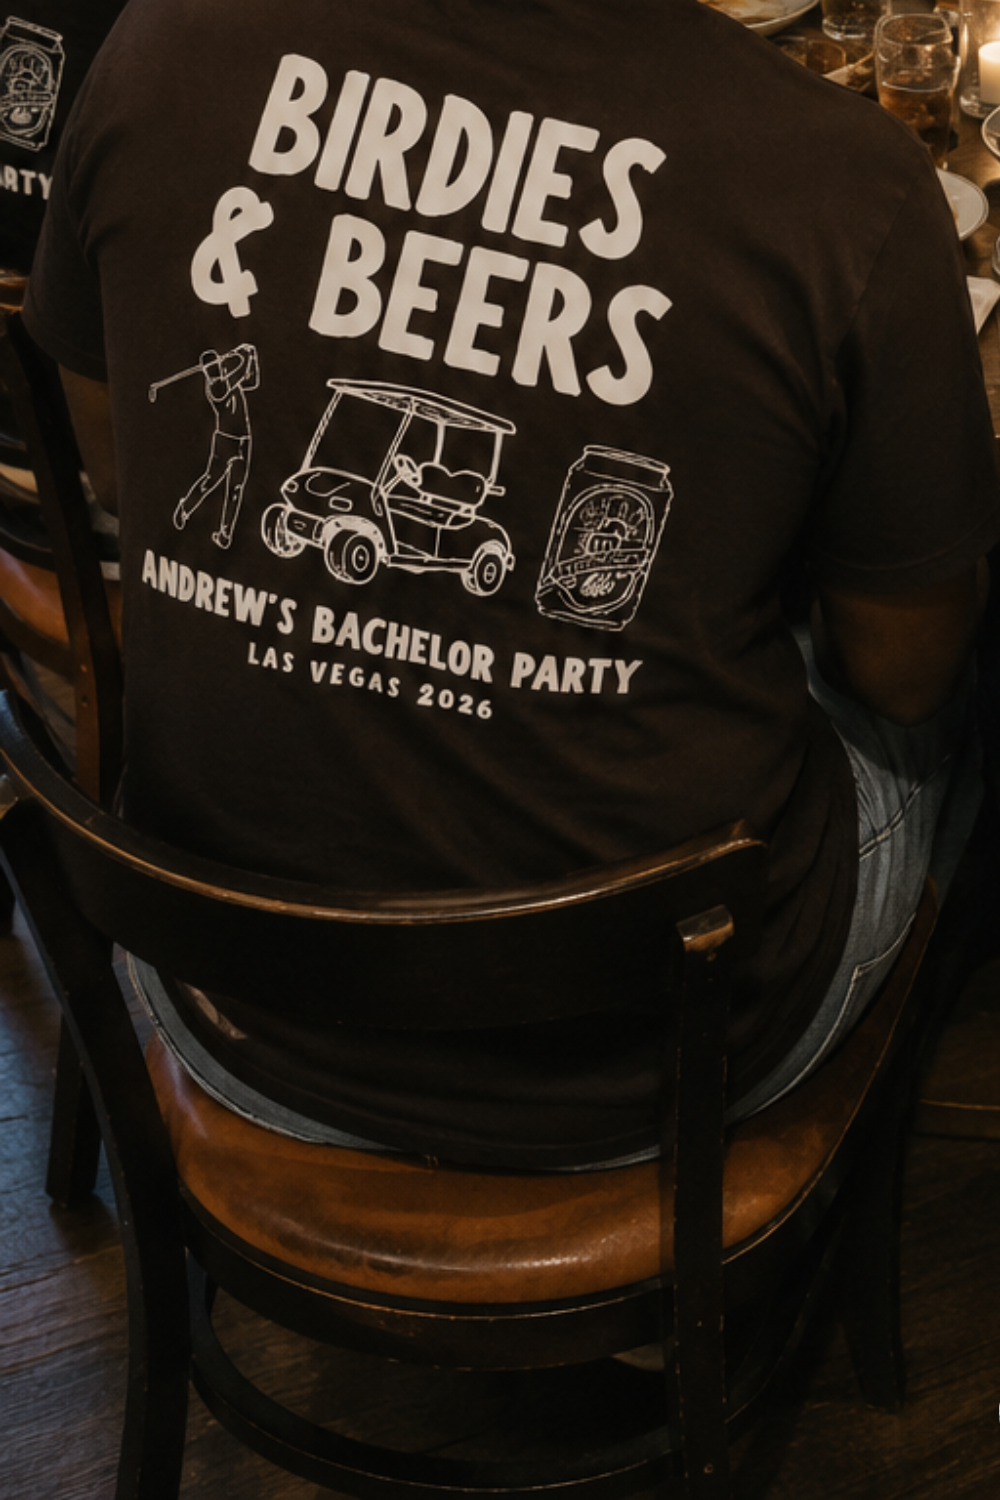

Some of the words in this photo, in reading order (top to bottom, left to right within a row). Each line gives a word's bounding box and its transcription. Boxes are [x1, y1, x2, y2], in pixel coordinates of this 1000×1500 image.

[247, 53, 667, 261] BIRDIES
[190, 185, 275, 319] &
[308, 213, 673, 406] BEERS
[141, 549, 298, 635] ANDREW'S
[311, 605, 495, 684] BACHELOR
[509, 651, 643, 695] PARTY
[247, 641, 295, 673] LAS
[310, 660, 401, 698] VEGAS
[416, 683, 493, 720] 2026
